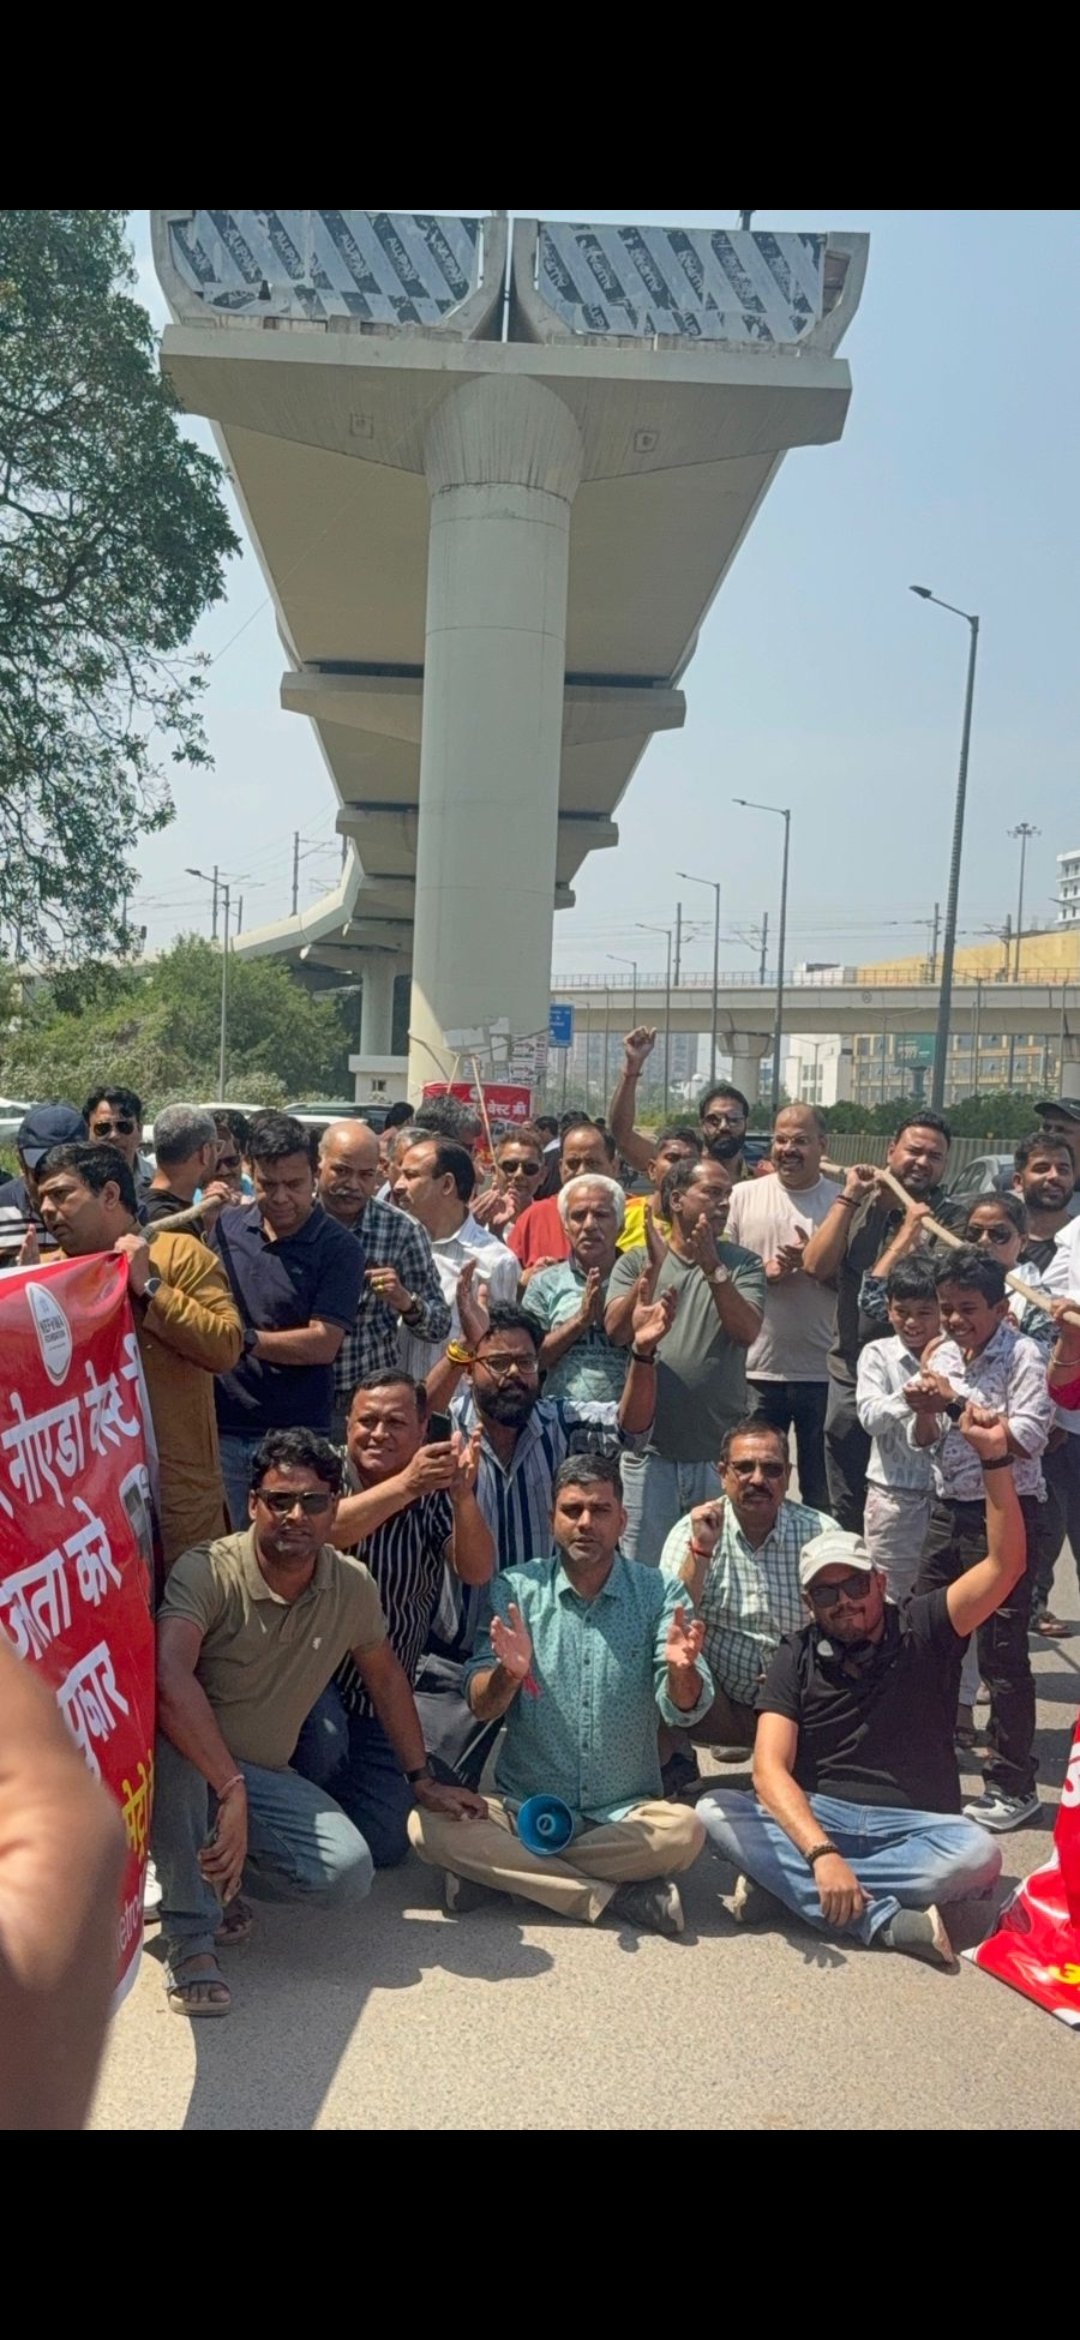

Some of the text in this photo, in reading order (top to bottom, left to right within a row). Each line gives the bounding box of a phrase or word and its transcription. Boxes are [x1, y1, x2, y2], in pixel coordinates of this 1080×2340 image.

[0, 1391, 85, 1508] नोएडा
[84, 1360, 141, 1456] वेस्ट
[61, 1497, 122, 1608] करे
